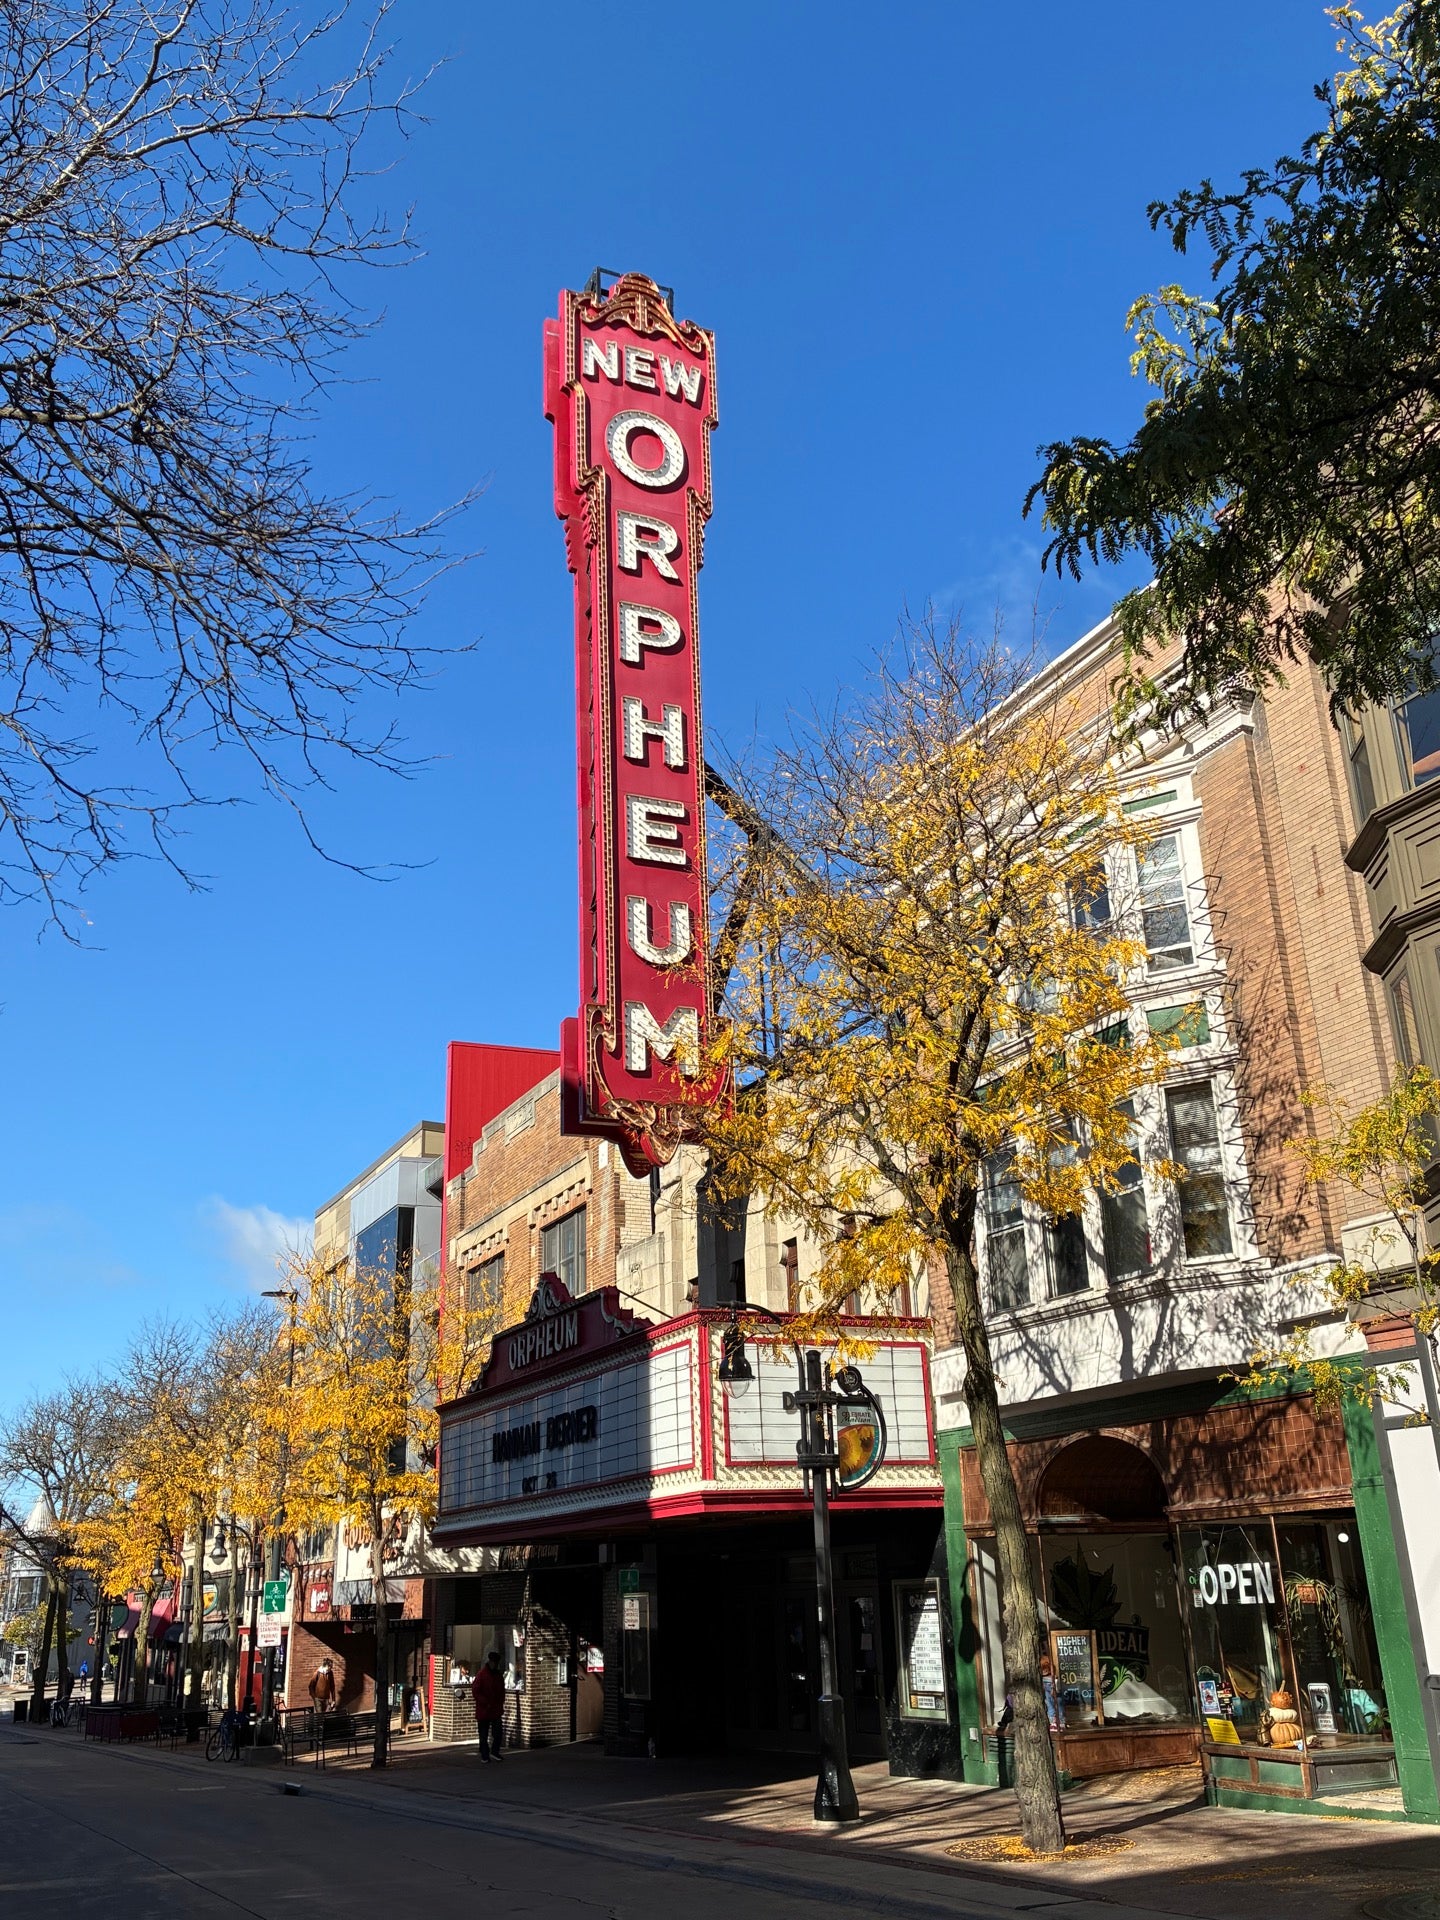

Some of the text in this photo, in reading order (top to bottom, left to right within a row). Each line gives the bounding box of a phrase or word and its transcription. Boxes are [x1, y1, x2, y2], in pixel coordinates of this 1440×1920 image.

[582, 337, 702, 403] NEW
[606, 409, 699, 1077] ORPHEUM
[508, 1311, 578, 1370] ORPHEUM
[546, 1404, 598, 1450] BERNER
[522, 1475, 538, 1493] OCT
[1199, 1562, 1276, 1605] OPEN
[1057, 1636, 1087, 1646] HIGHER
[1059, 1646, 1084, 1656] IDEAL
[1100, 1631, 1147, 1655] IDEAL
